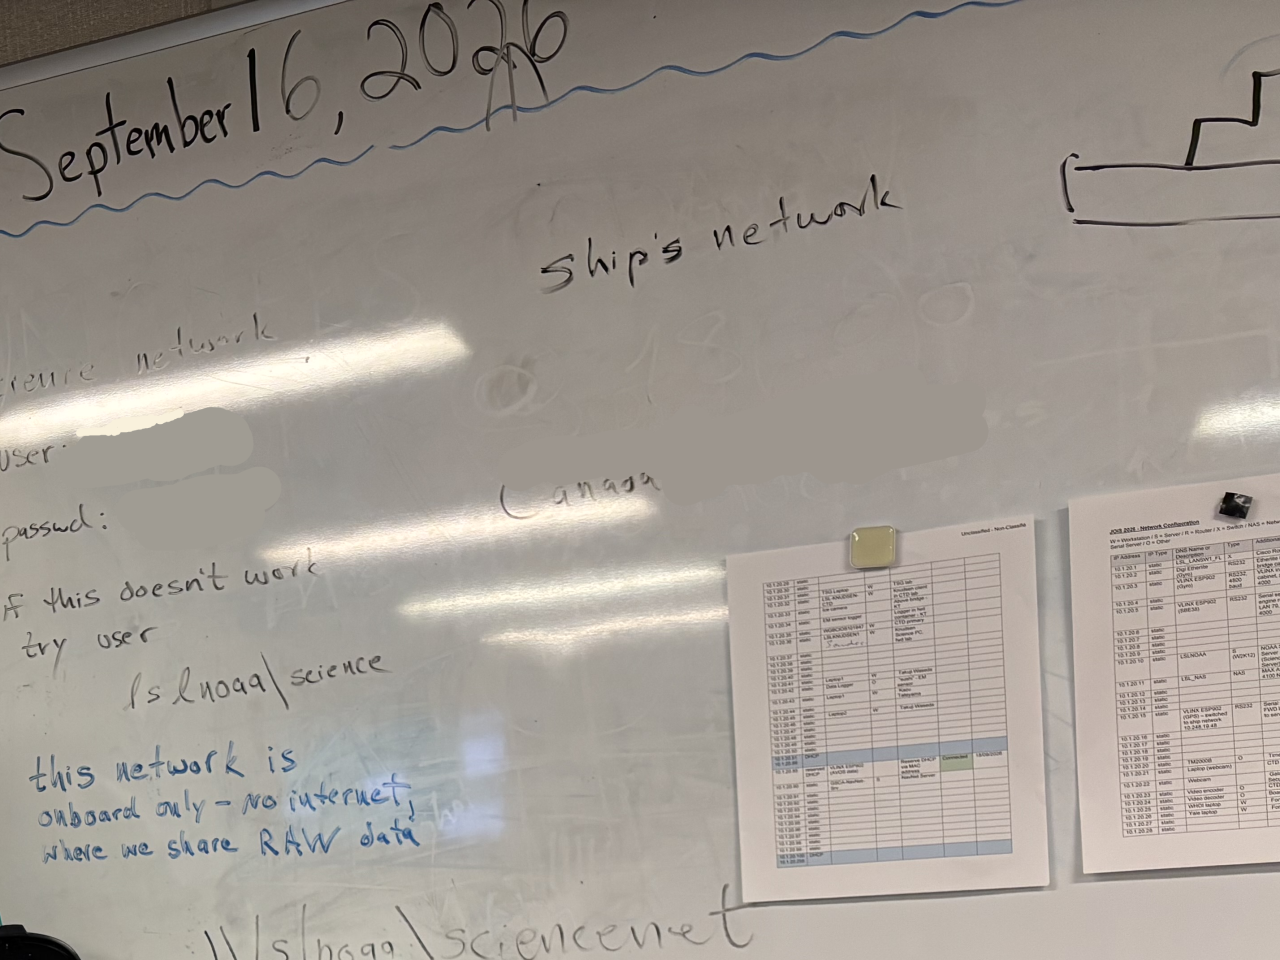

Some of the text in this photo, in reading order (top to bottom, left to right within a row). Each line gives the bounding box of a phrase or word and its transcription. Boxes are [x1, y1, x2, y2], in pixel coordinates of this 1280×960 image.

[360, 0, 570, 101] 2026
[539, 173, 904, 295] ship's network
[135, 311, 276, 376] network
[1110, 542, 1125, 550] Serial
[1121, 535, 1151, 543] Workstation
[1140, 523, 1162, 532] Network
[1163, 519, 1200, 530] Configuration
[42, 586, 101, 614] this
[120, 562, 230, 603] doesn't
[243, 547, 322, 587] work
[22, 626, 159, 682] try user
[29, 740, 299, 794] this network is
[36, 795, 141, 829] onboard
[155, 789, 207, 824] only
[41, 818, 421, 866] where we share RAW data
